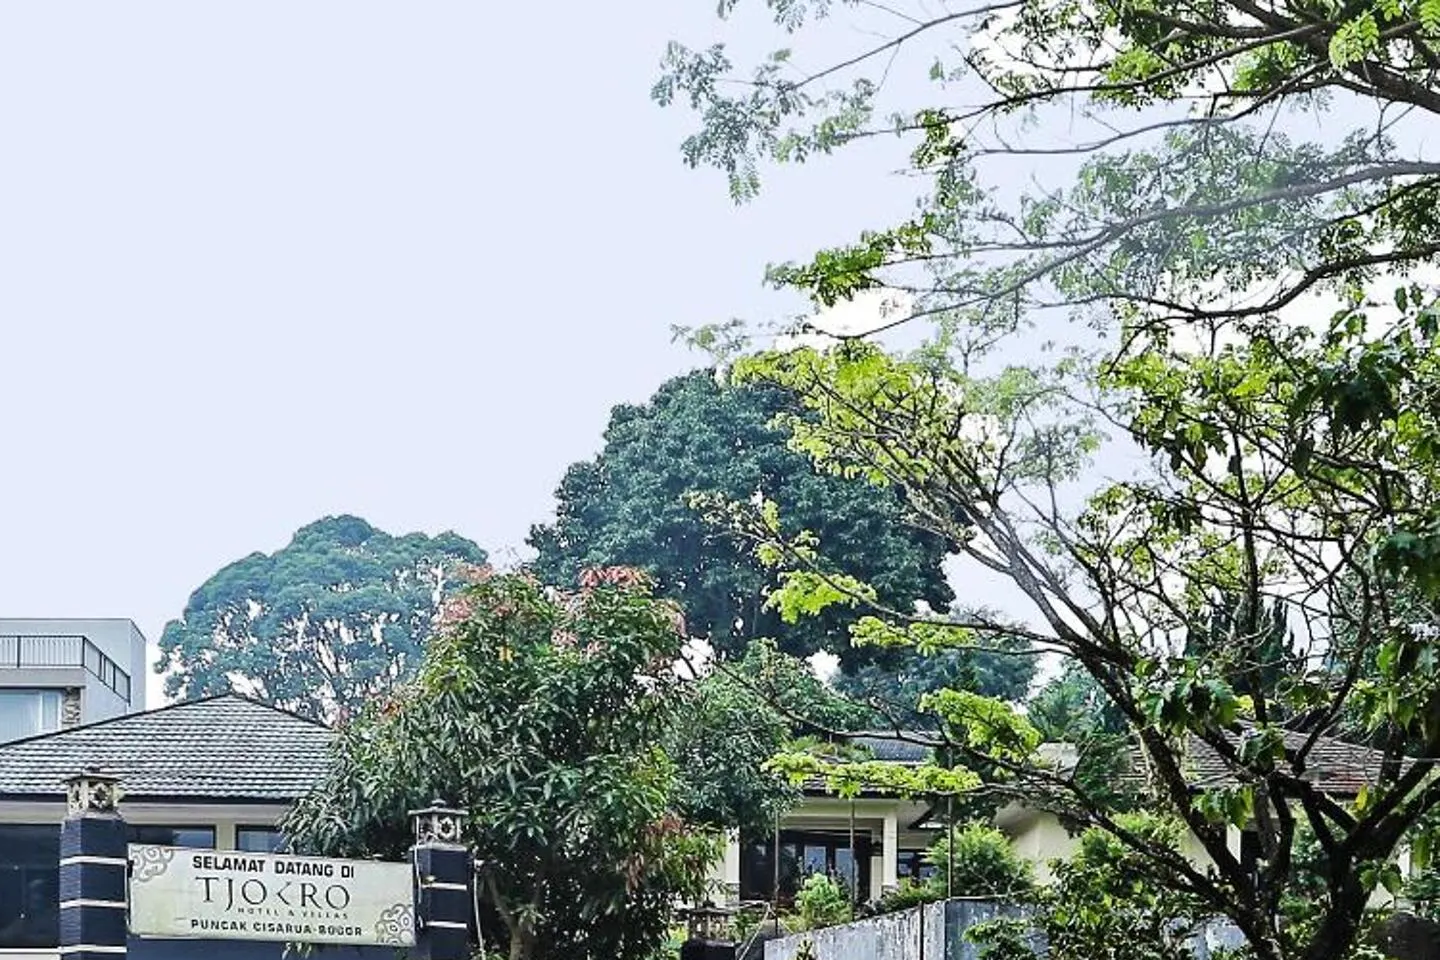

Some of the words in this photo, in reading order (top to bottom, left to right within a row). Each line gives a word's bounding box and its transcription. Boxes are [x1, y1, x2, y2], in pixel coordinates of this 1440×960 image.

[192, 856, 265, 872] SELAMAT
[275, 861, 333, 877] DATANG
[341, 865, 354, 878] DI
[195, 876, 350, 912] TJOKRO
[238, 907, 279, 916] HOTEL
[302, 911, 348, 919] VILLAS
[191, 919, 247, 931] PUNCAK
